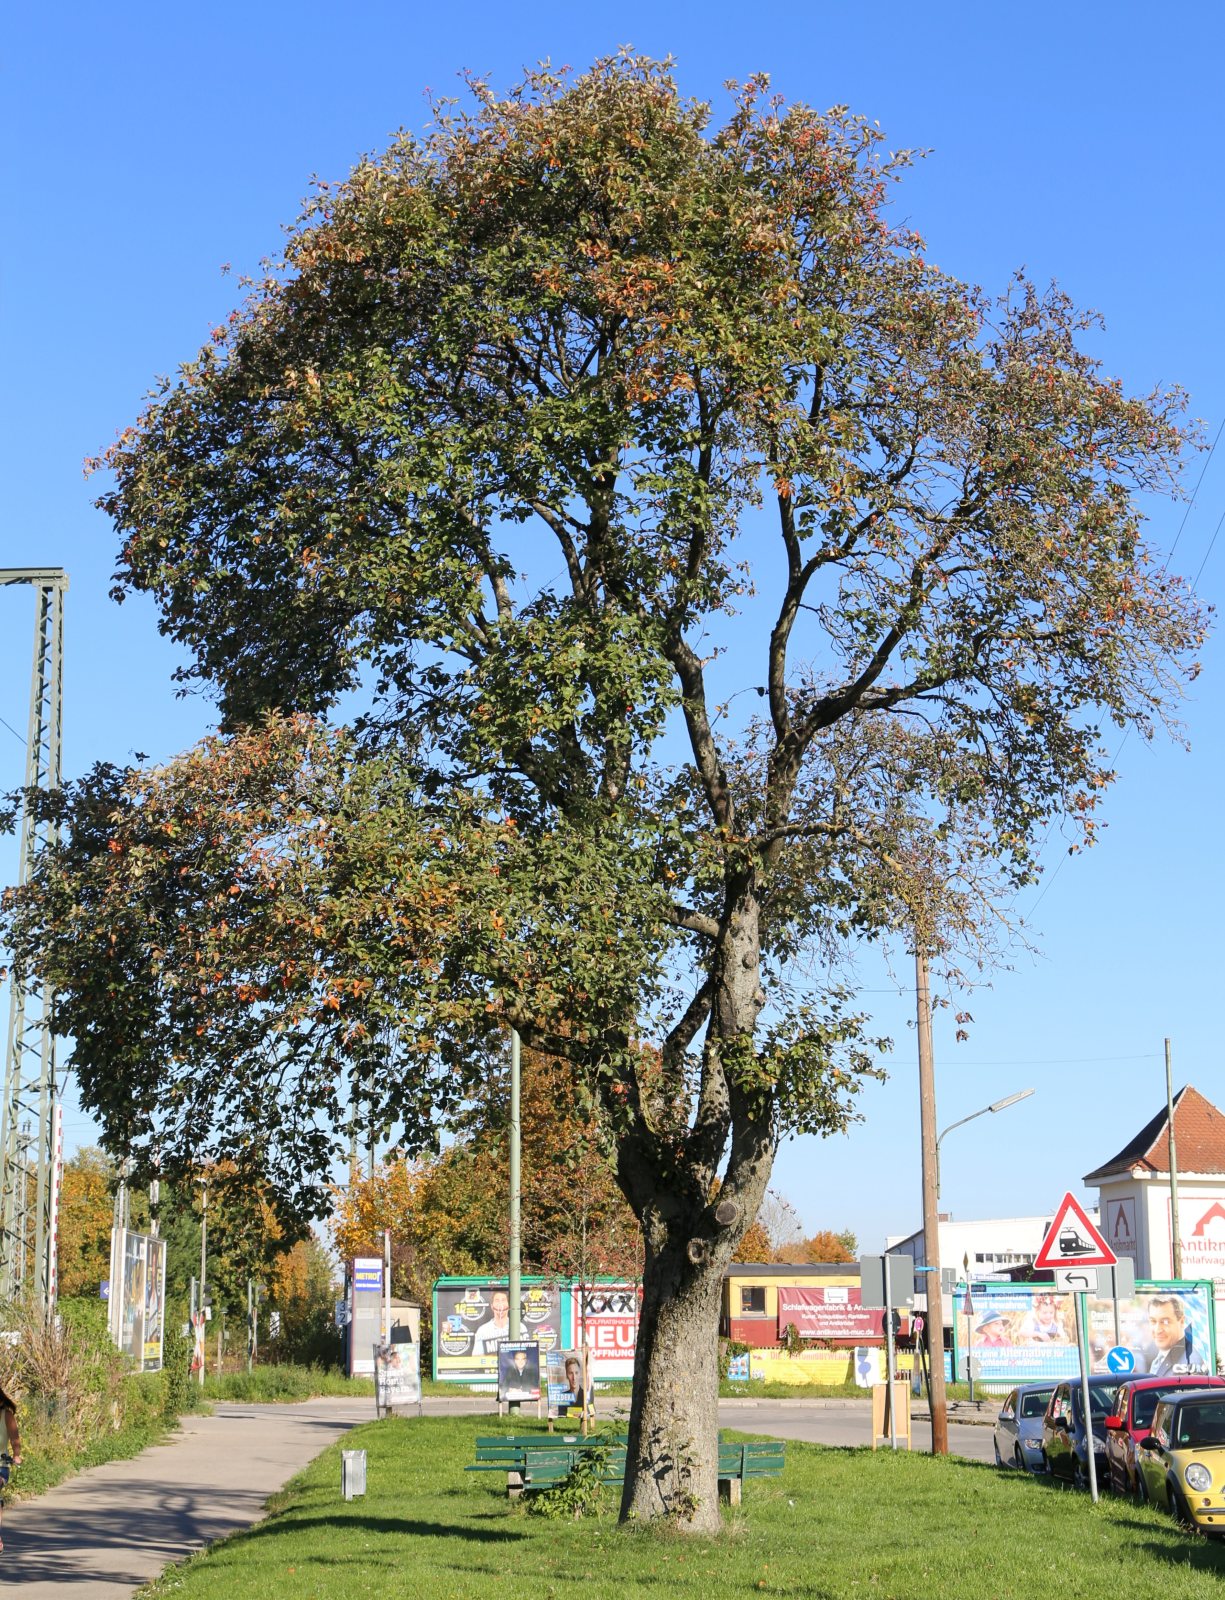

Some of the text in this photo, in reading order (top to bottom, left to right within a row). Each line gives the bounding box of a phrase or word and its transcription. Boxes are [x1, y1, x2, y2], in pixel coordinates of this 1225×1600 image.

[1181, 1256, 1225, 1266] chlafwag
[340, 1301, 346, 1312] 3
[782, 1304, 846, 1312] Schlafwagenfabrik
[340, 1312, 346, 1323] 2
[577, 1325, 635, 1348] NEU
[591, 1348, 635, 1357] ÖFFNUNG
[1000, 1347, 1053, 1358] Alternative
[1172, 1363, 1195, 1373] CSU
